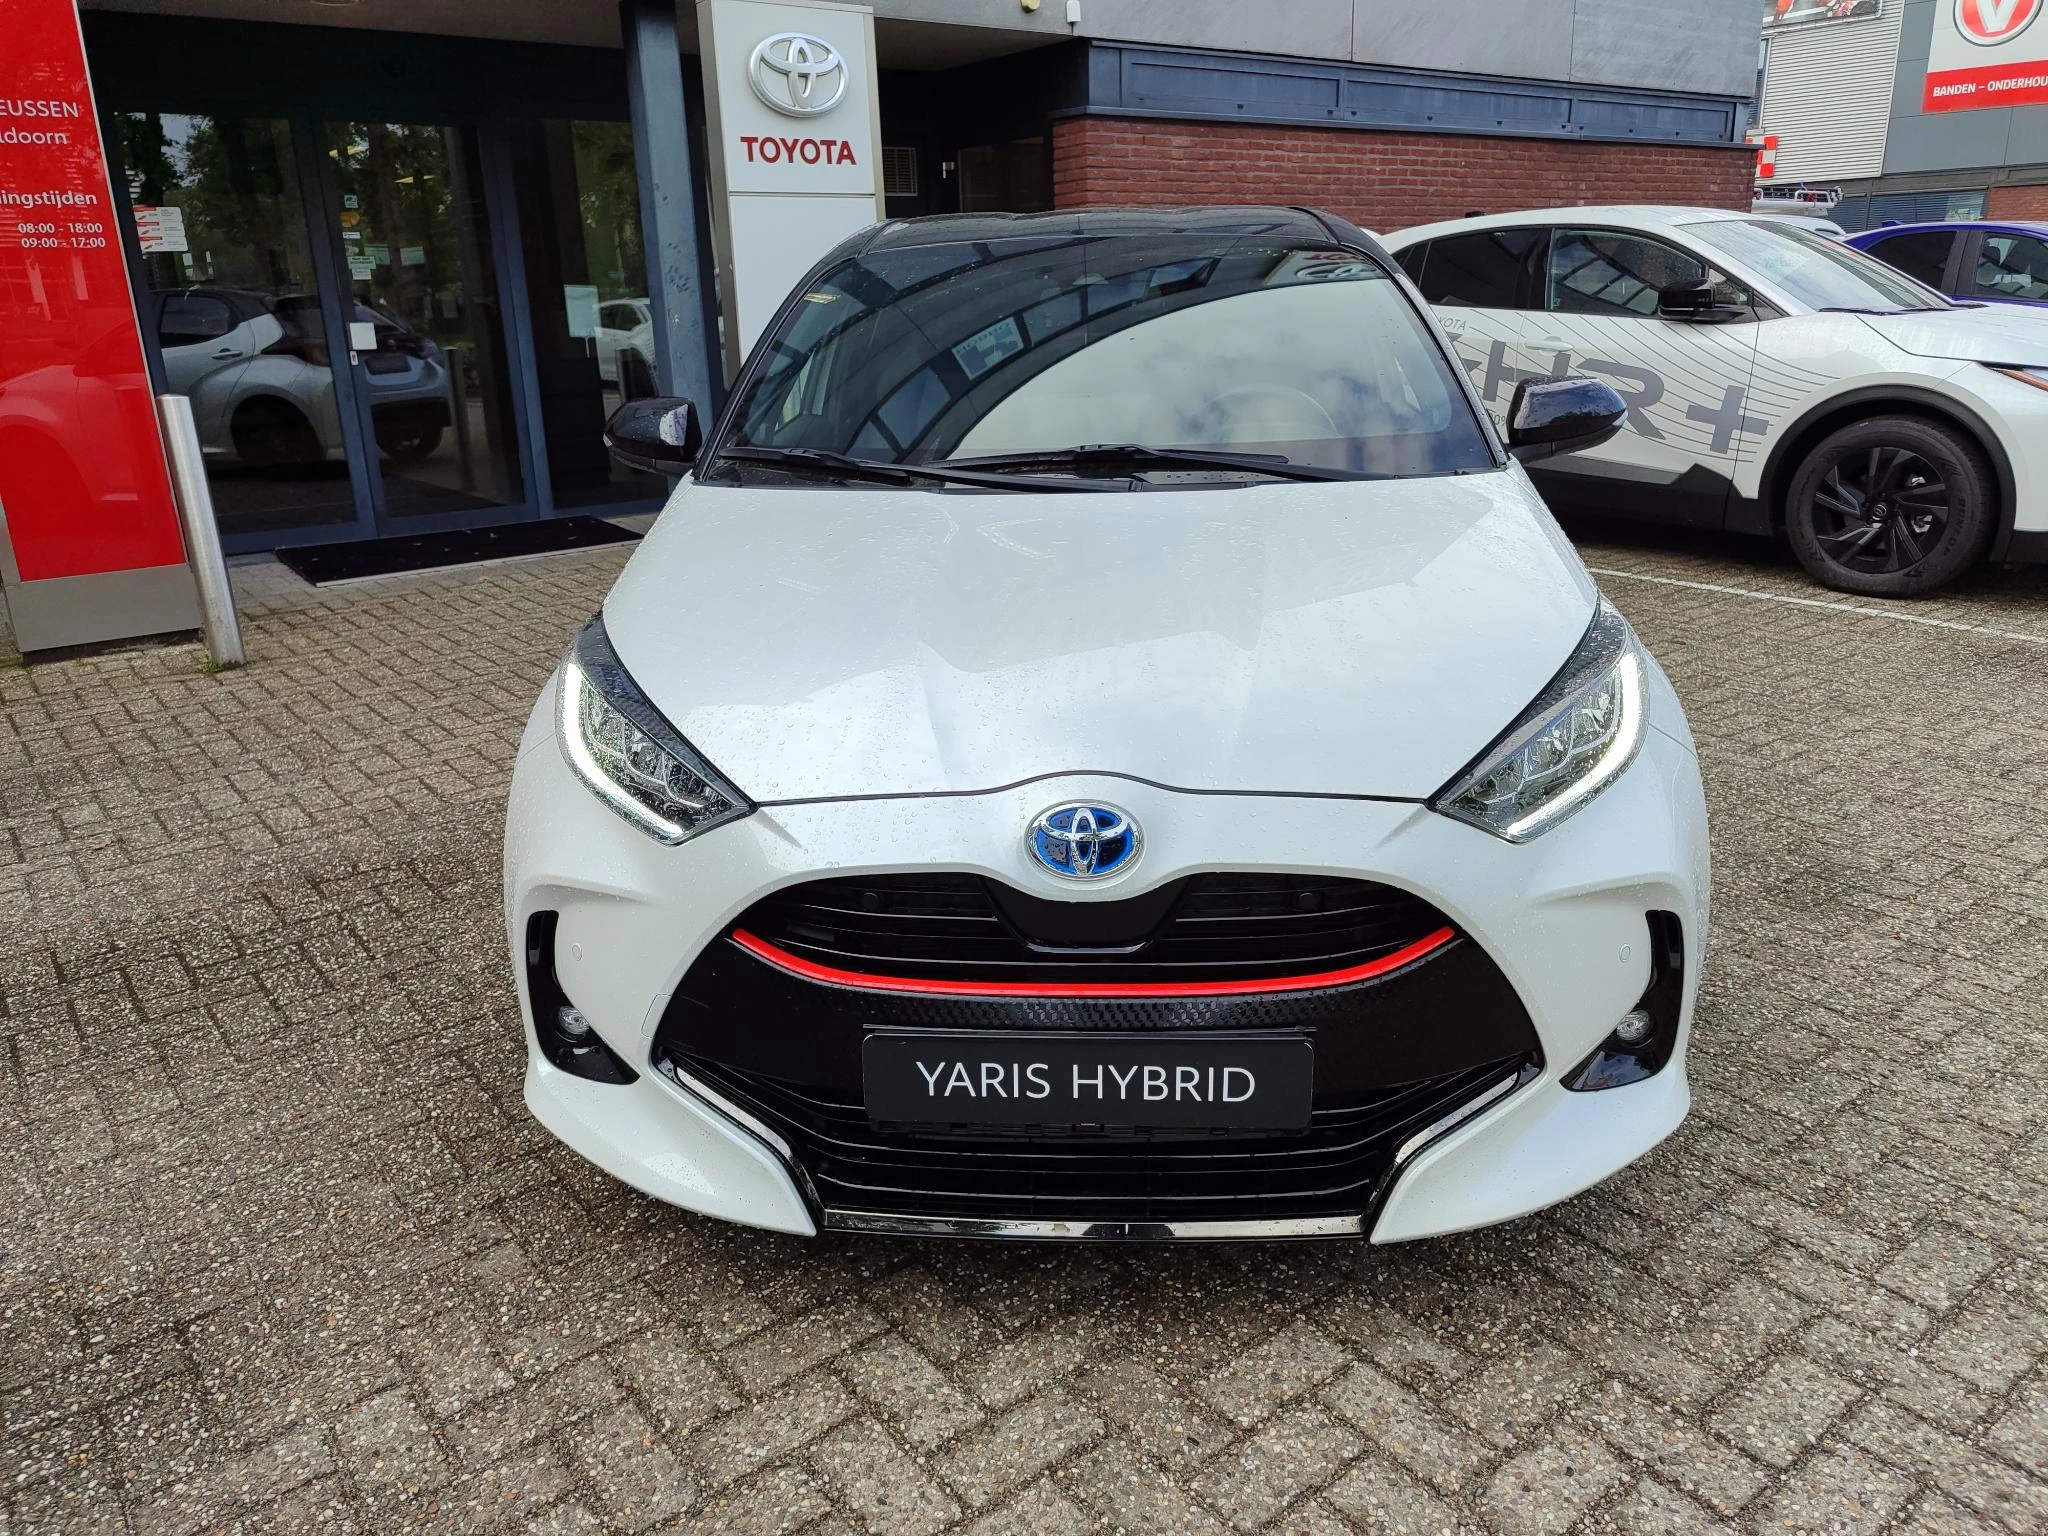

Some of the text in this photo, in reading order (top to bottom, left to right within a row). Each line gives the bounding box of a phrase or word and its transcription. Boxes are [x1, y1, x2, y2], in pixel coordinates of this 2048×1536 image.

[1933, 83, 1976, 97] BANDEN
[1987, 75, 2048, 92] ONDERHOU
[0, 99, 79, 118] EUSSEN
[740, 136, 856, 165] TOYOTA
[0, 190, 98, 209] ingstijden
[18, 222, 55, 234] 08:00
[68, 222, 103, 234] 18:00
[22, 237, 57, 248] 09:00
[71, 237, 106, 248] 17:00
[915, 1061, 1256, 1102] YARIS HYBRID
